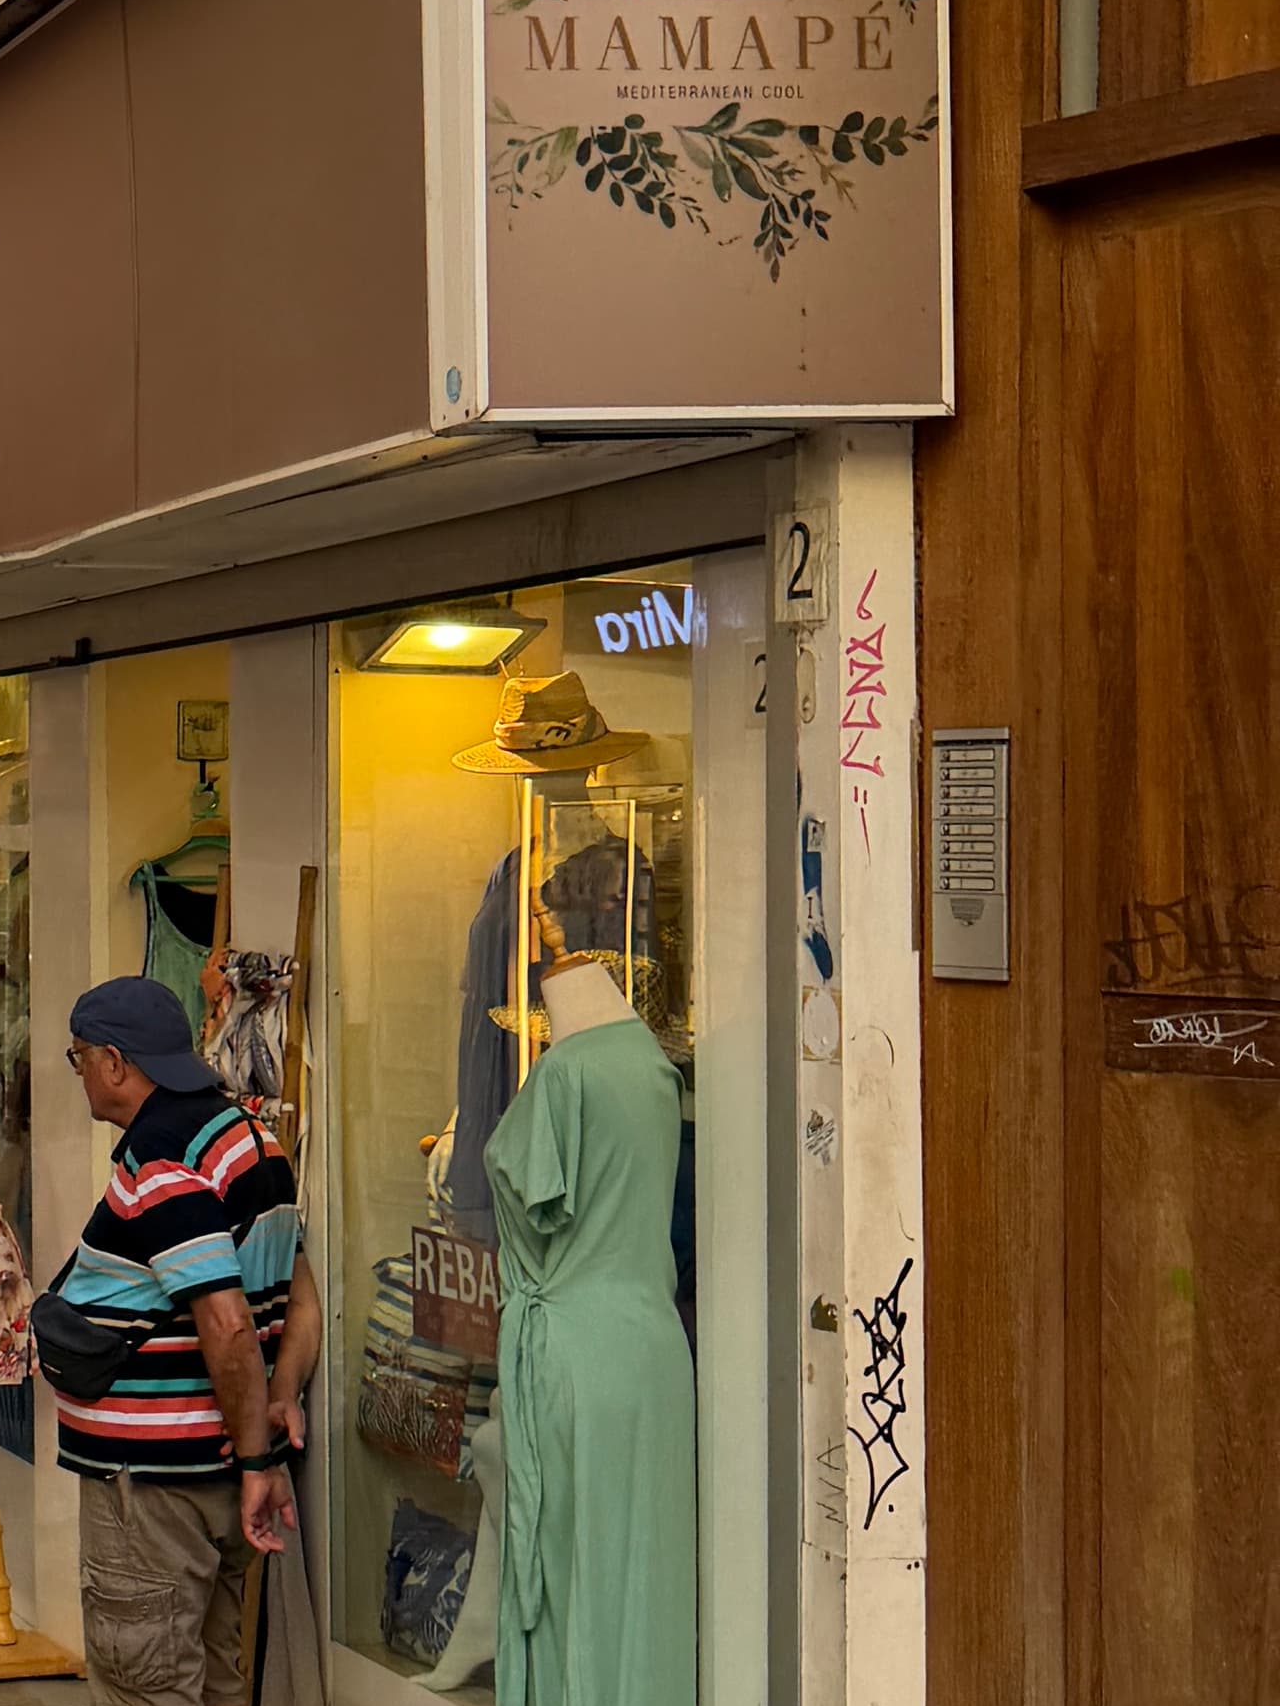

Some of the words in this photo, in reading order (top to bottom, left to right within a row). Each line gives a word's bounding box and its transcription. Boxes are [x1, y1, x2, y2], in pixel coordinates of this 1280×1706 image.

[525, 0, 893, 71] MAMAPÉ
[616, 84, 754, 100] MEDITERRANEAN
[761, 84, 805, 100] COOL
[787, 521, 813, 600] 2
